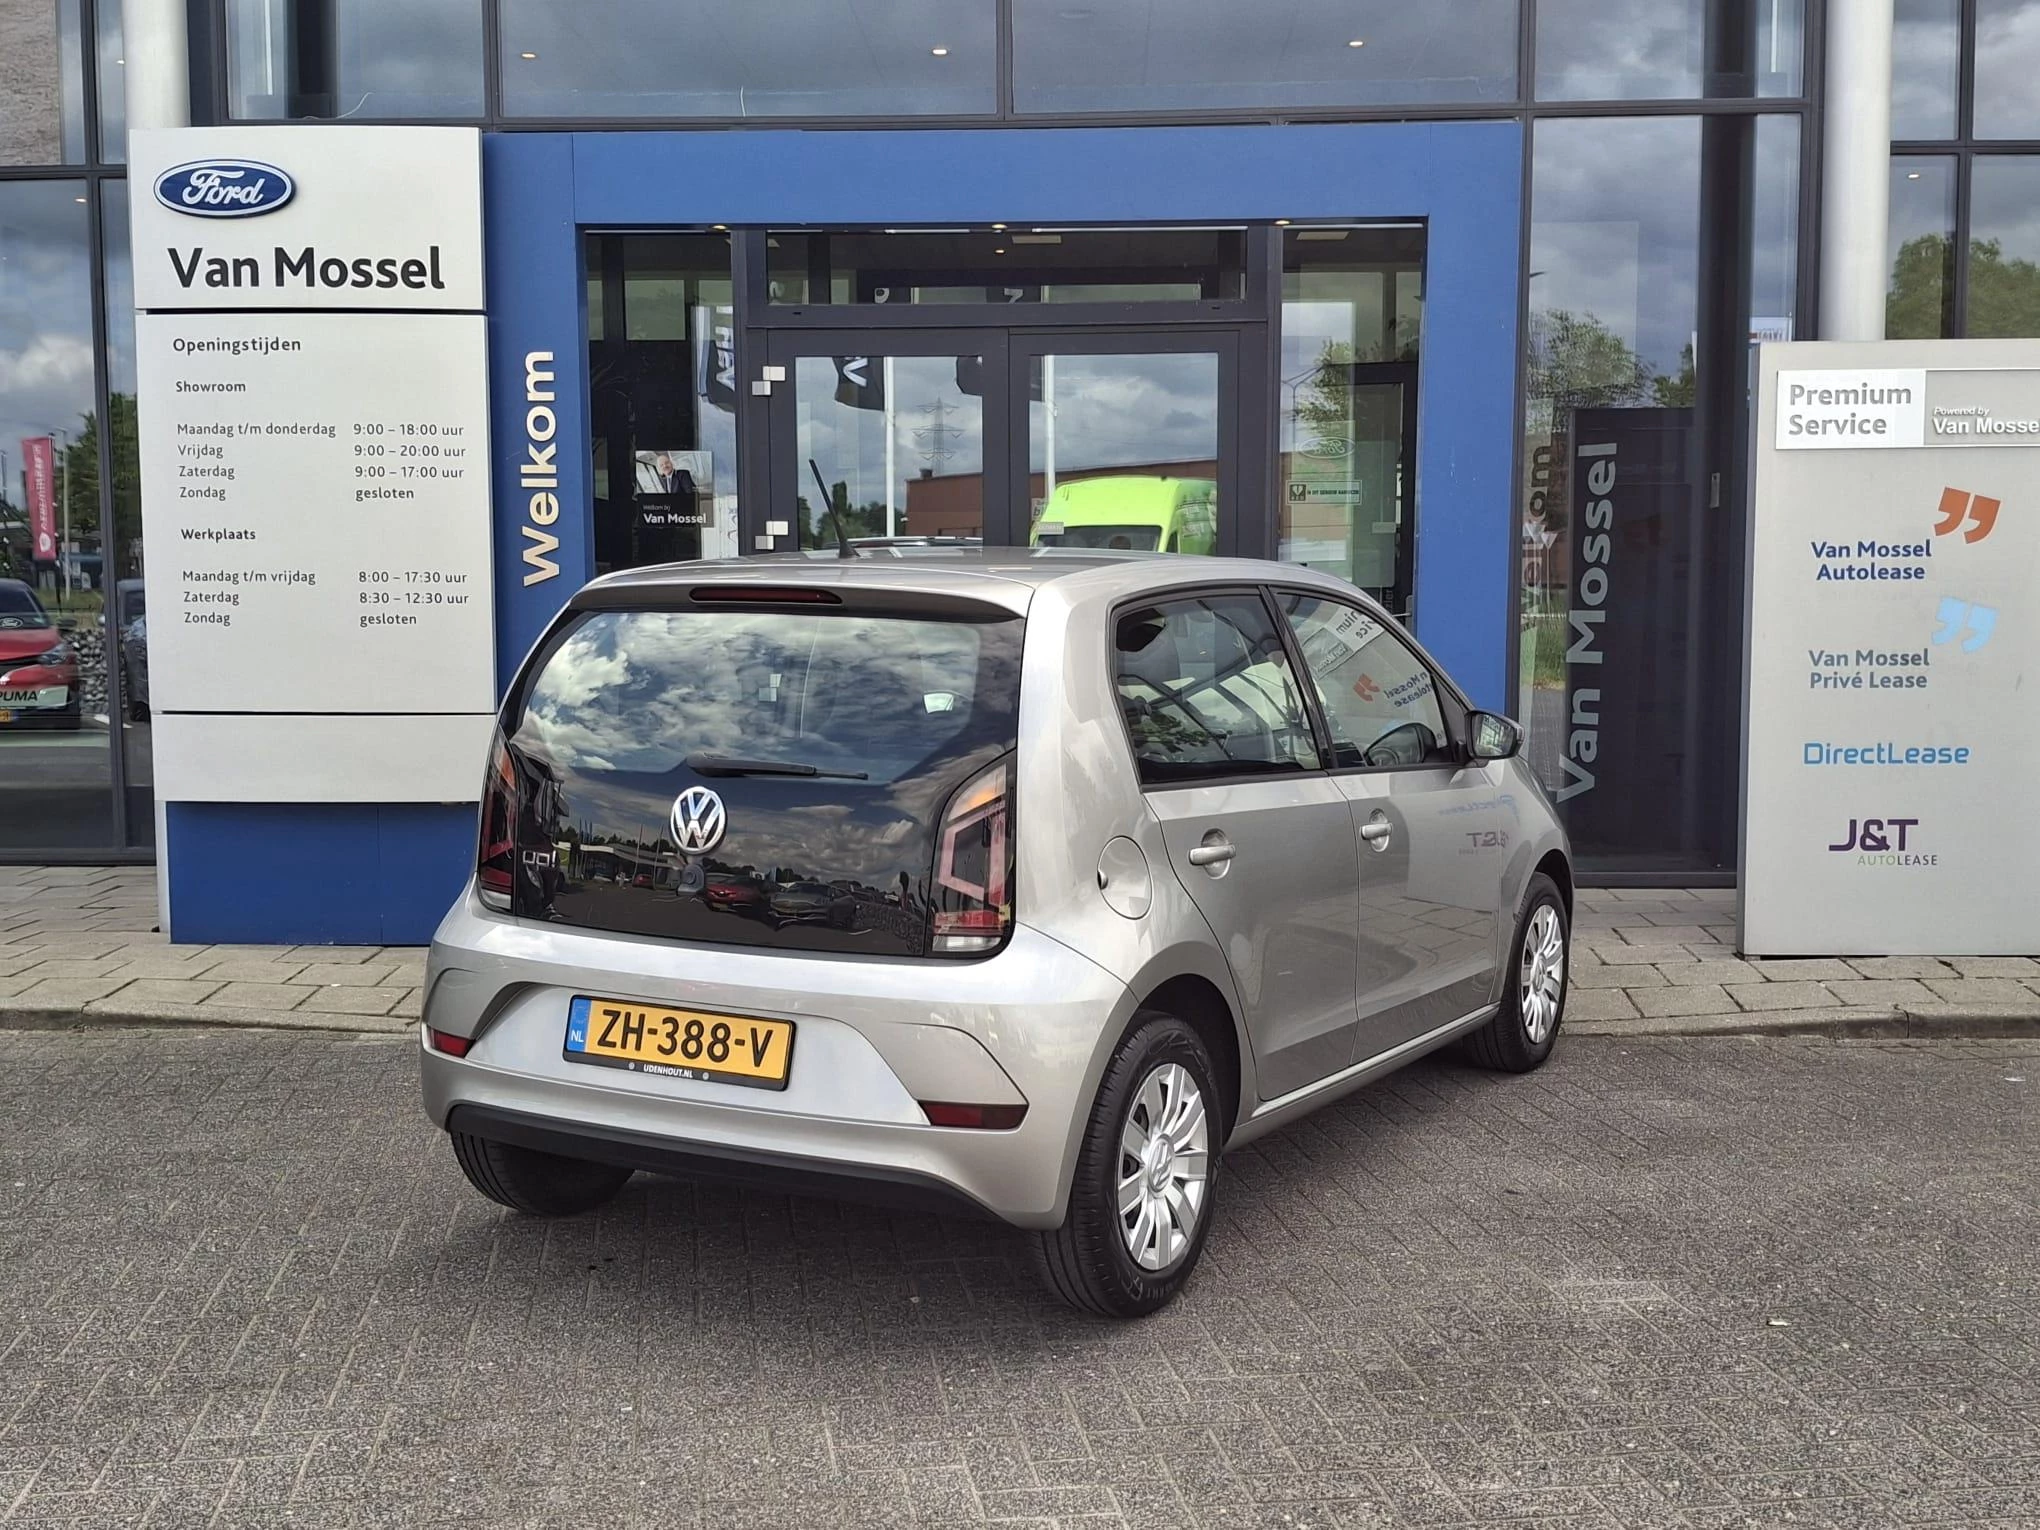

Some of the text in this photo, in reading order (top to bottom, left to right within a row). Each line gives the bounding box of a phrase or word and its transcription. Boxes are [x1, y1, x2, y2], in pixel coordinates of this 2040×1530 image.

[182, 169, 264, 206] Ford
[166, 245, 446, 290] Van Mossel
[172, 336, 301, 357] Openingstijden
[175, 380, 246, 393] Showroom
[1789, 381, 1912, 406] Premium
[1933, 406, 1990, 417] Powered by
[177, 422, 235, 439] Maandag
[237, 422, 262, 435] t/m
[265, 421, 337, 439] donderdag
[353, 423, 384, 436] 9:00
[399, 423, 438, 436] 18:00
[441, 426, 465, 436] uur
[1788, 411, 1887, 436] Service
[1933, 417, 2040, 435] Van Mosse
[177, 443, 224, 460] Vrijdag
[354, 444, 385, 457] 9:00
[399, 444, 440, 457] 20:00
[443, 447, 466, 457] uur
[178, 464, 236, 481] Zaterdag
[354, 465, 386, 478] 9:00
[400, 465, 438, 479] 17:00
[441, 469, 465, 479] uur
[520, 351, 560, 587] Welkom
[179, 485, 415, 503] Zondag gesloten
[643, 513, 707, 524] Van Mossel
[180, 527, 256, 544] Werkplaats
[1810, 538, 1933, 559] Van Mossel
[182, 569, 240, 586] Maandag
[242, 569, 267, 583] t/m
[270, 569, 316, 586] vrijdag
[358, 570, 390, 583] 8:00
[404, 571, 441, 584] 17:30
[445, 574, 468, 584] uur
[1815, 561, 1926, 581] Autolease
[183, 590, 240, 607] Zaterdag
[359, 591, 390, 604] 8:30
[404, 592, 443, 604] 12:30
[446, 595, 470, 604] uur
[183, 611, 417, 628] Zondag gesloten
[1556, 443, 1618, 803] Van Mossel
[1807, 647, 1931, 667] Van Mossel
[1810, 670, 1928, 689] Privé Lease
[1803, 741, 1970, 765] DirectLease
[1828, 818, 1919, 852] J&T
[1856, 853, 1941, 867] AUTOLEASE
[570, 1029, 585, 1043] NL
[597, 1009, 774, 1068] ZH-388-V
[643, 1063, 694, 1079] UDENHOUT.NL
